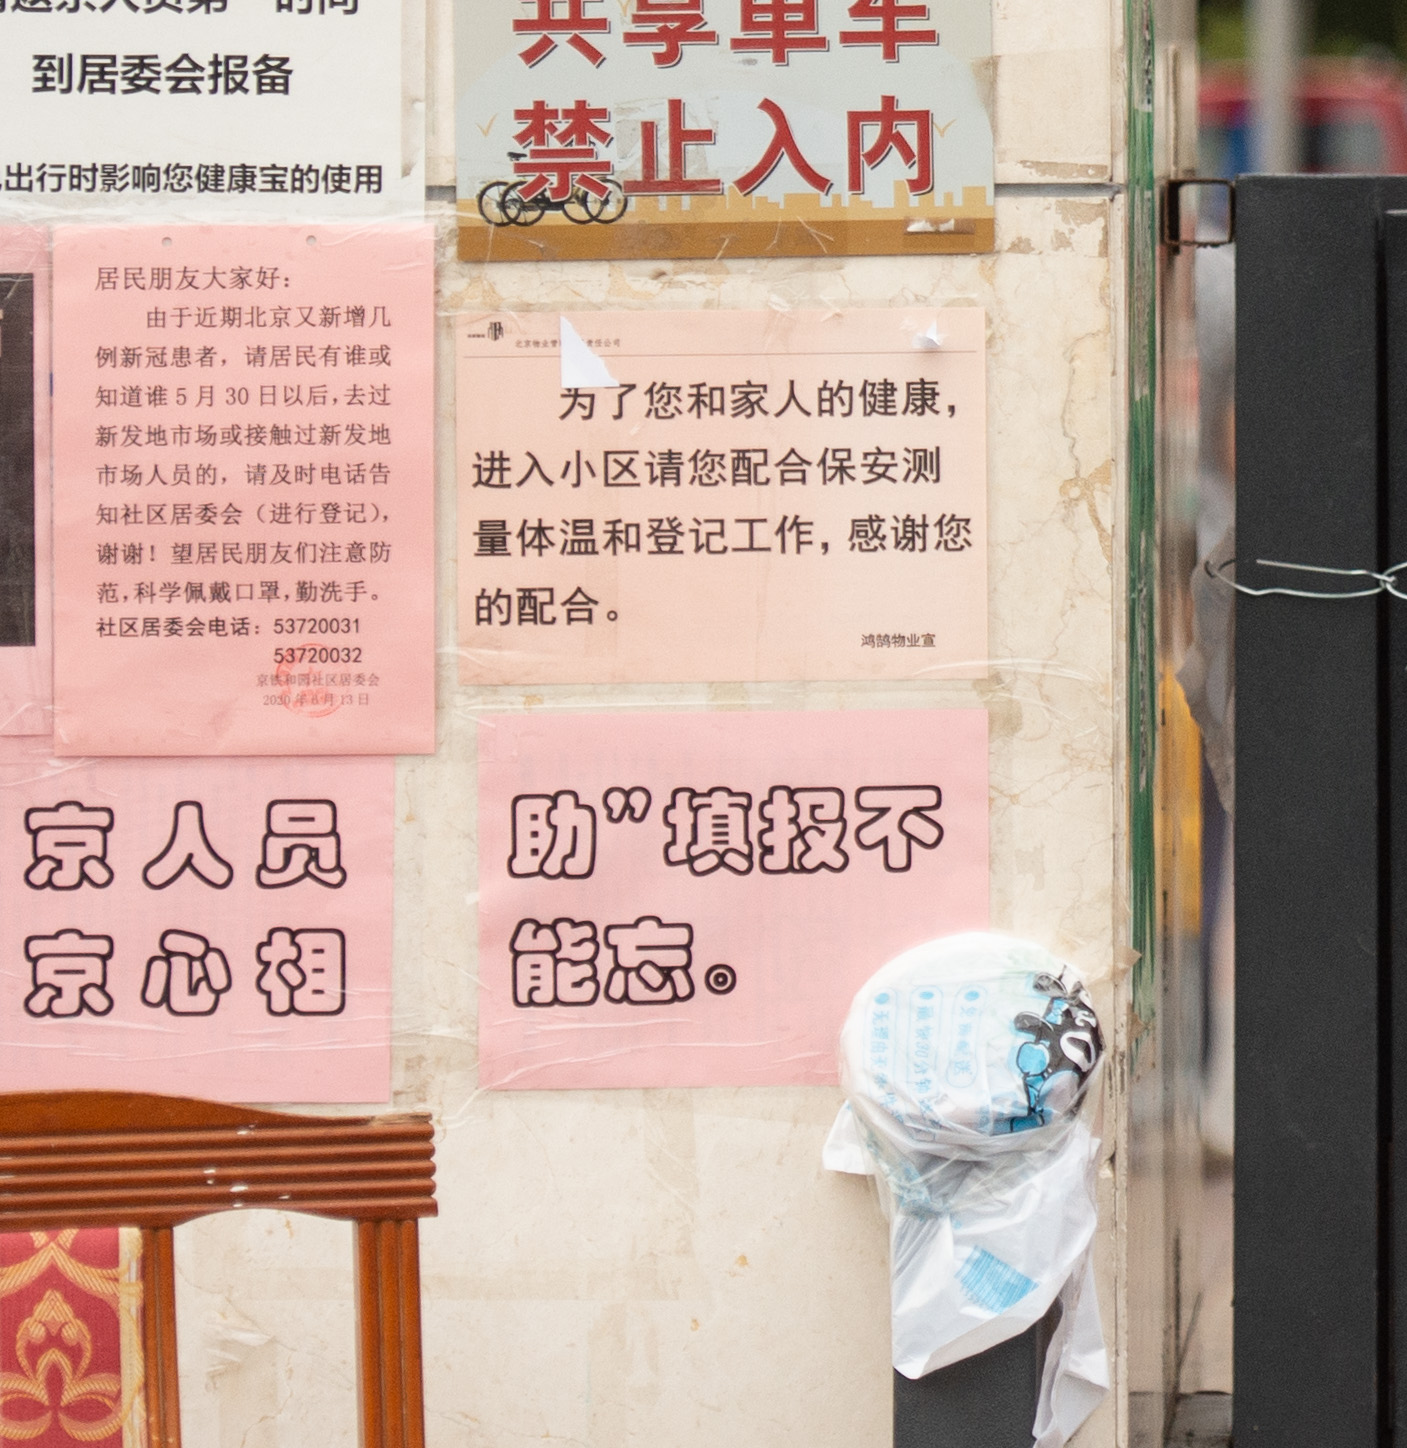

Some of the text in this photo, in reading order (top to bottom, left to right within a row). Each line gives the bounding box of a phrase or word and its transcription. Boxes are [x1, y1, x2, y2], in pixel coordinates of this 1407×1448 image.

[32, 52, 294, 96] 到居委会报备
[512, 94, 936, 203] 禁止入内
[0, 162, 383, 195] 出行时影响您健康宝的使用
[95, 265, 291, 291] 居民朋友大家好：
[146, 304, 392, 330] 由于近期北京又新增几
[95, 343, 392, 370] 例新冠患者，请居民有谁或
[558, 379, 958, 421] 为了您和家人的健康，
[95, 422, 392, 448] 新发地市场或接触过新发地
[95, 461, 391, 487] 市场人员的，请及时电话告
[471, 445, 941, 489] 进入小区请您配合保安测
[472, 513, 973, 558] 量体温和登记工作，感谢您
[96, 580, 381, 605] 范，科学佩戴口罩，勤洗手。
[475, 586, 623, 627] 的配合。
[273, 646, 362, 665] 53720032
[24, 798, 348, 892] 京人员
[24, 926, 347, 1019] 京心相
[508, 915, 737, 1009] 能忘。
